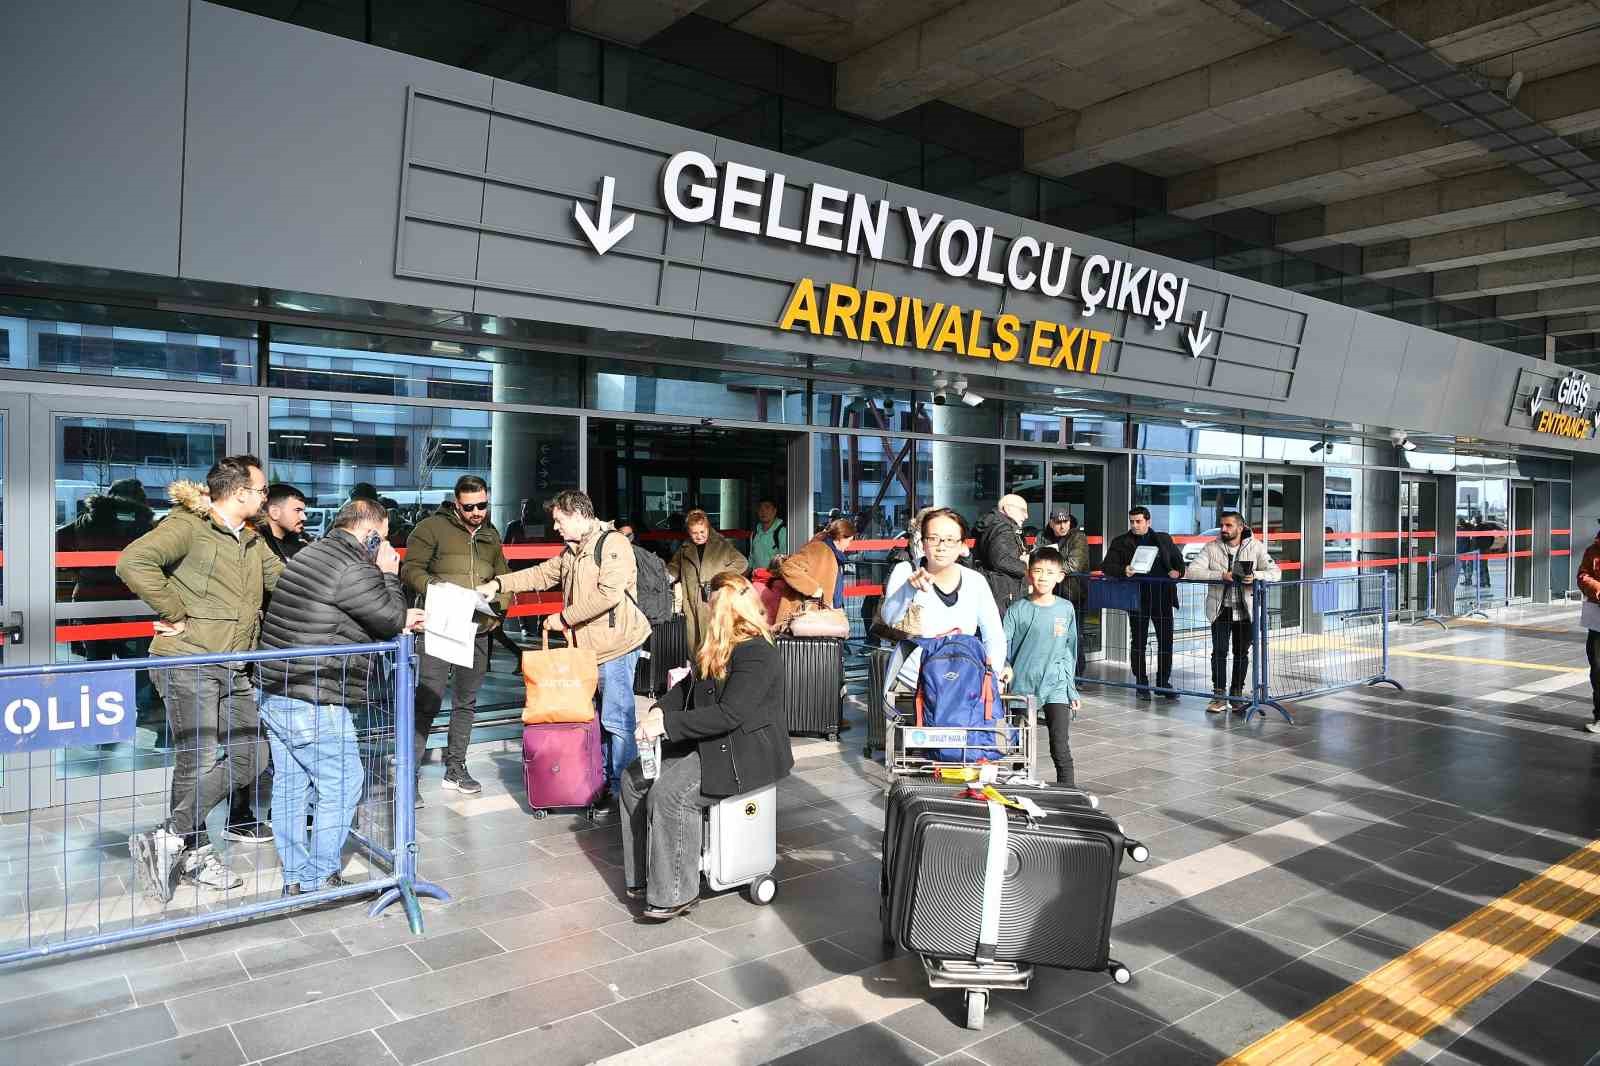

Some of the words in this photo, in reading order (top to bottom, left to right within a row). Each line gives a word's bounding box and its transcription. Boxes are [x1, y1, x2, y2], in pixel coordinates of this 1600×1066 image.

[663, 150, 890, 260] GELEN
[906, 206, 1072, 297] YOLCU
[1080, 254, 1190, 331] ÇIKIŞI
[779, 278, 1021, 362] ARRIVALS
[1028, 319, 1113, 375] EXIT
[1537, 408, 1591, 439] ENTRANCE
[1557, 371, 1591, 414] GİRİŞ
